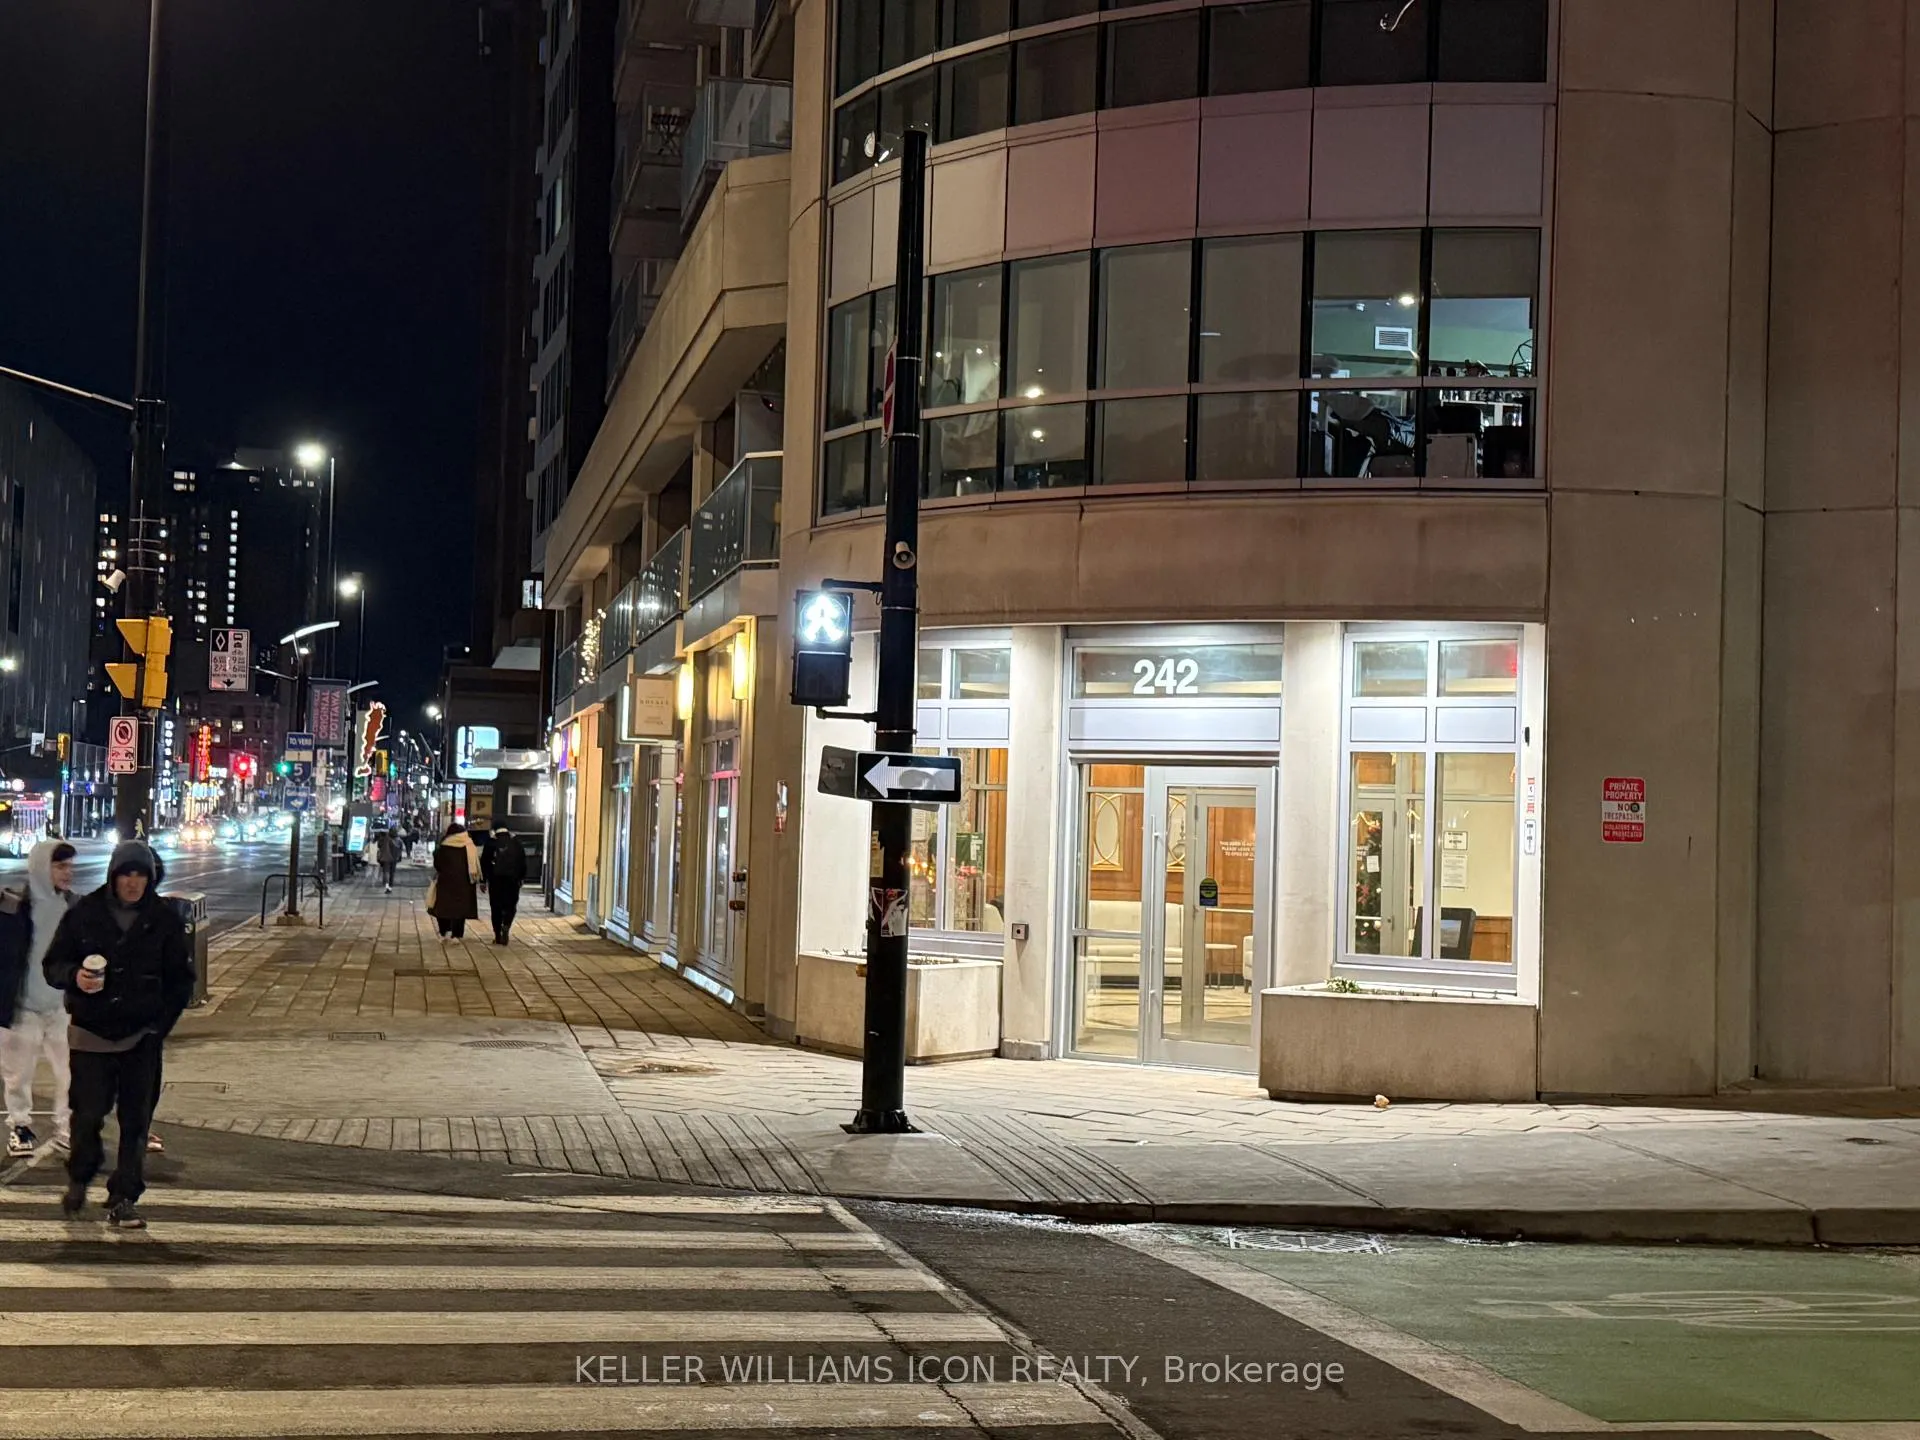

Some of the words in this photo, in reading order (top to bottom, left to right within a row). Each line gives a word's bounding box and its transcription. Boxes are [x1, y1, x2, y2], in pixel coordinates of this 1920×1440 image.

[1133, 658, 1199, 695] 242
[293, 763, 304, 777] 5
[1609, 782, 1639, 791] PRIVATE
[1605, 791, 1642, 800] PROPERTY
[1617, 803, 1631, 811] NO
[1604, 812, 1643, 820] TRESPASSING
